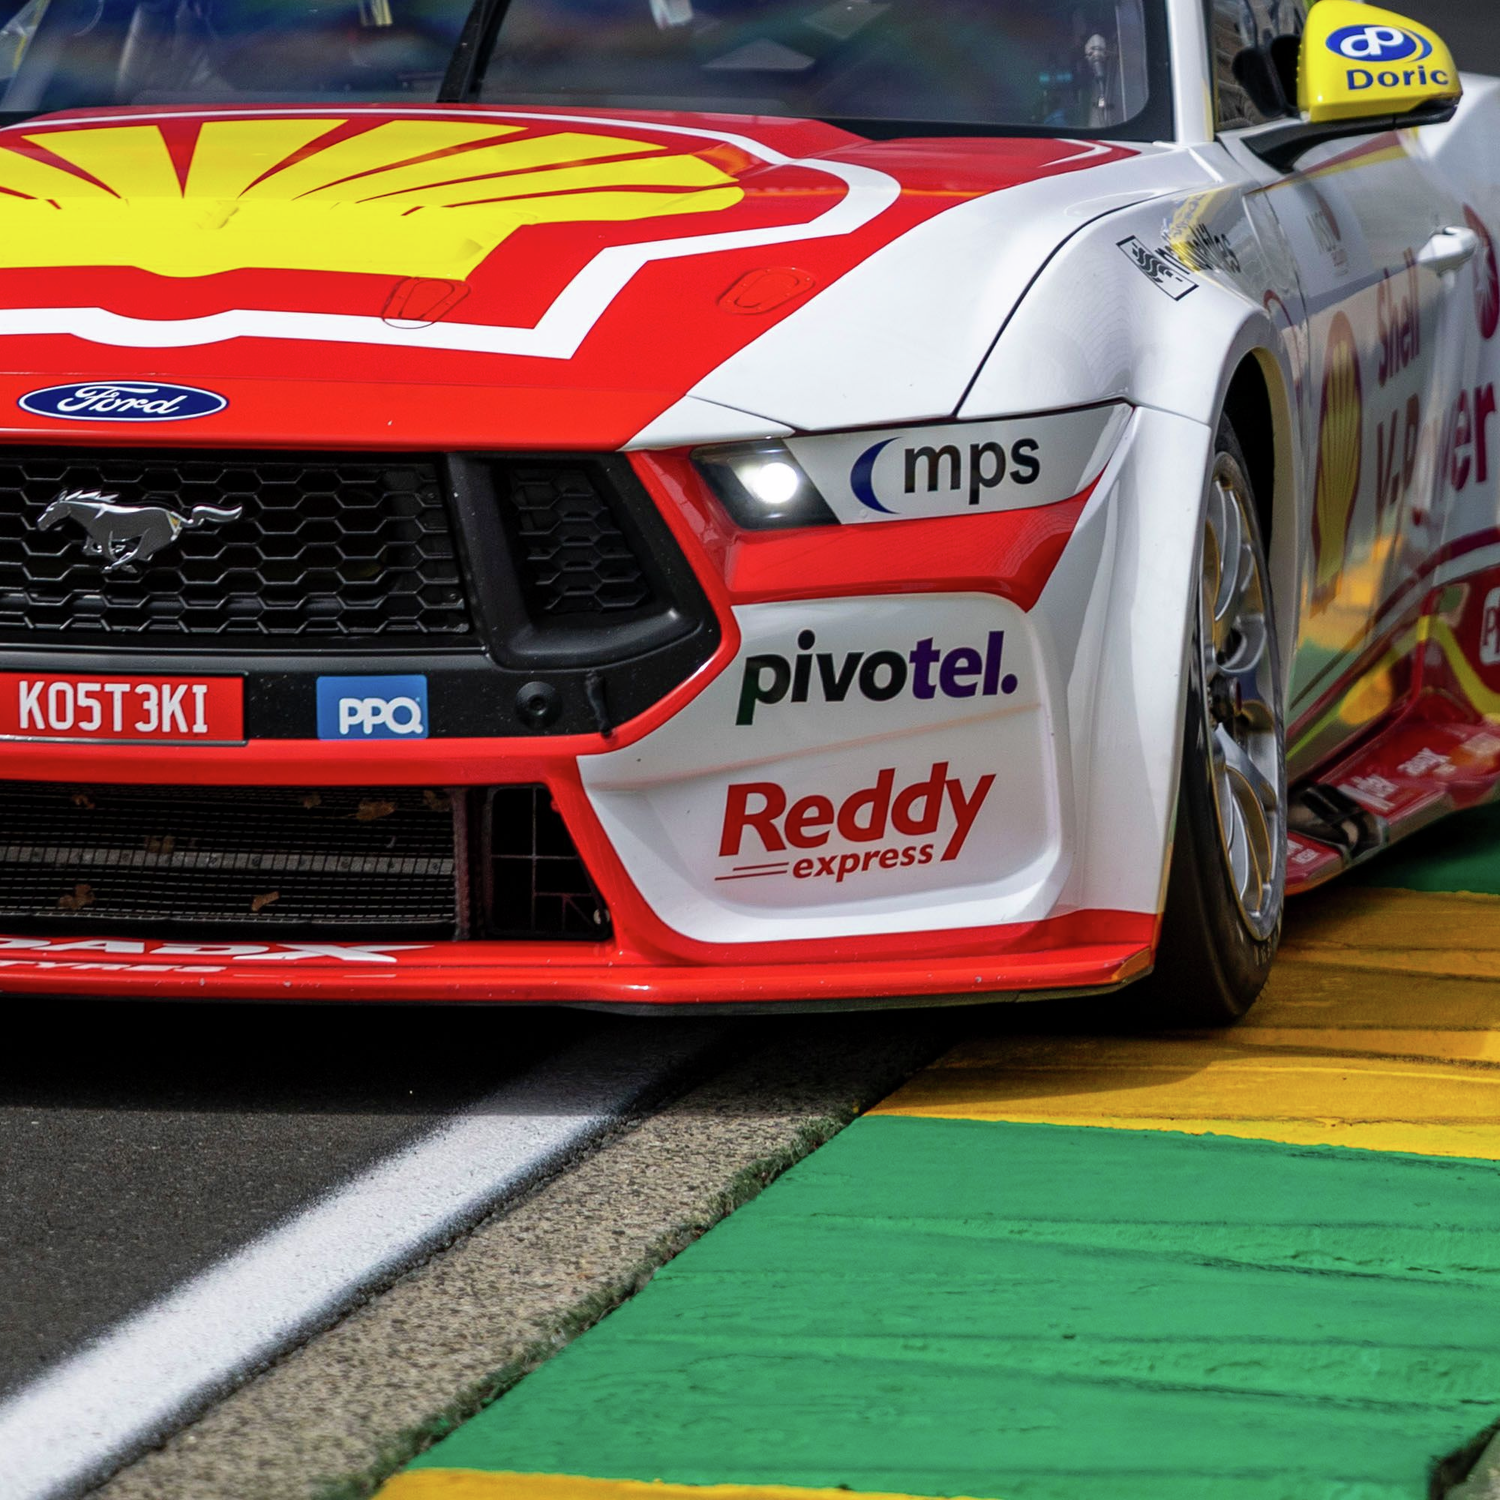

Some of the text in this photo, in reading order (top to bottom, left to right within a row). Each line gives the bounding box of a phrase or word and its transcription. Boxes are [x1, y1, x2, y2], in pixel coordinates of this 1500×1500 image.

[1346, 65, 1449, 90] Doric
[57, 385, 189, 414] Ford
[903, 437, 1041, 505] mps
[735, 629, 1019, 726] pivotel.
[338, 696, 424, 736] PPQ
[717, 760, 997, 863] Reddy
[791, 843, 934, 884] express
